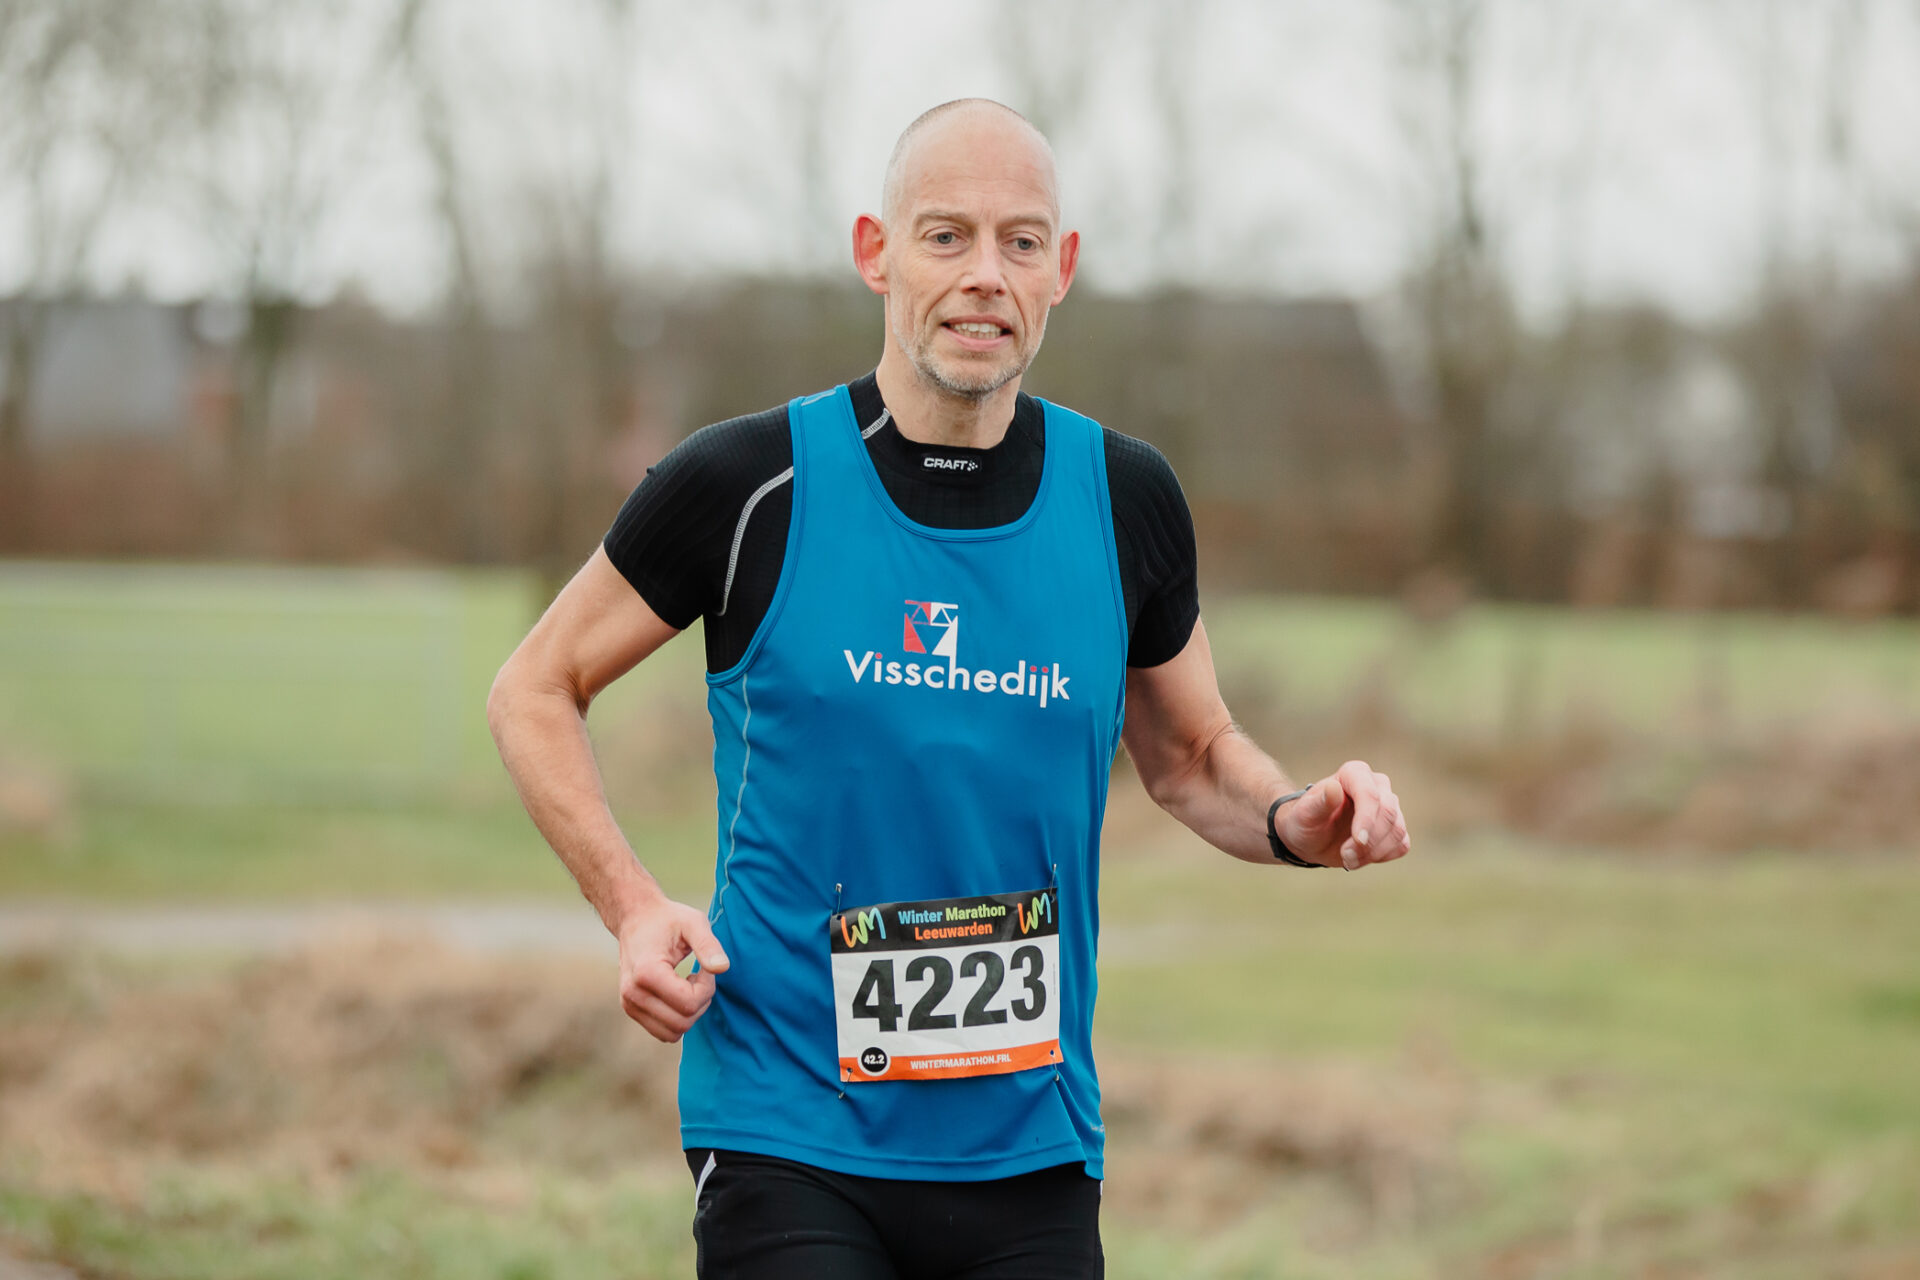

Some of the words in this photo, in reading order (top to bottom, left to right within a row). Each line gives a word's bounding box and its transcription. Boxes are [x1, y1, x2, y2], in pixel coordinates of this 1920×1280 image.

[923, 457, 968, 471] CRAFT
[843, 649, 1070, 708] Visschedijk
[898, 910, 943, 925] Winter
[945, 904, 1006, 921] Marathon
[914, 922, 993, 941] Leeuwarden
[852, 944, 1047, 1032] 4223
[864, 1054, 885, 1065] 42.2
[910, 1053, 1012, 1070] WINTERMARATHON.FRL
